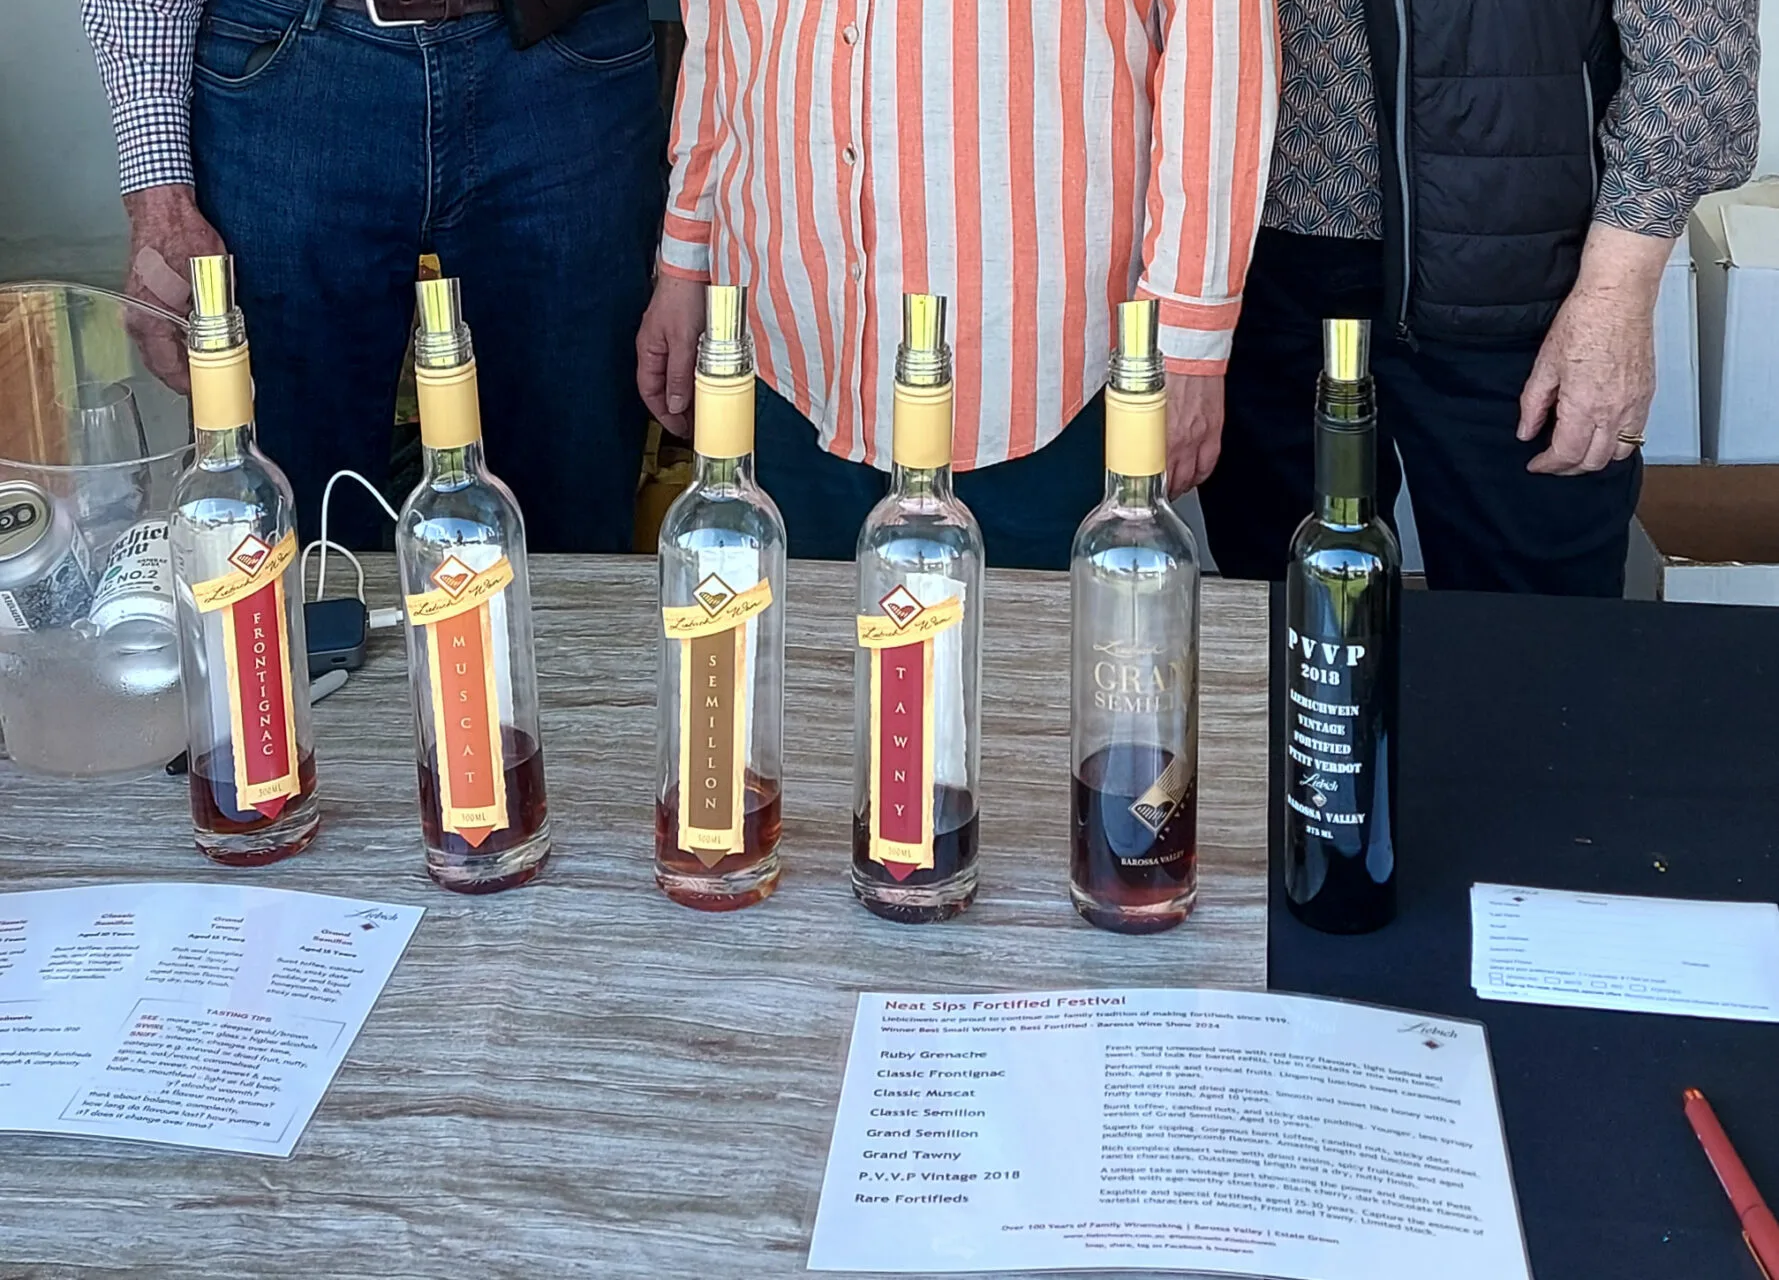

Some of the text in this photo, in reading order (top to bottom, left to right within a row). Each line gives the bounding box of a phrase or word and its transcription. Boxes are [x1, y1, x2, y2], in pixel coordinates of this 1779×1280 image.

[117, 570, 158, 584] NO.2
[1300, 663, 1341, 686] 2018
[253, 612, 275, 757] FRONTIGNAC
[452, 635, 475, 784] MUSCAT
[1290, 688, 1360, 716] LIEBICHWEIN
[704, 654, 719, 810] SEMILLON
[1297, 713, 1346, 736] VINTAGE
[893, 666, 909, 818] TAWNY
[1293, 730, 1352, 755] FORTIFIED
[1288, 744, 1363, 774] PETIT VERDOT
[1287, 794, 1366, 825] BAROSSA VALLEY
[1121, 850, 1185, 866] BAROSSA VALLEY
[885, 996, 1126, 1013] Neat Sips Fortified Festival
[206, 1008, 272, 1022] TASTING TIPS
[1064, 1012, 1093, 1020] family
[1153, 1011, 1187, 1019] making
[972, 1025, 1007, 1035] Winery
[880, 1050, 987, 1061] Ruby Grenache
[877, 1069, 1006, 1080] Classic Frontignac
[873, 1088, 976, 1098] Classic Muscat
[869, 1108, 986, 1118] Classic Semillon
[866, 1128, 979, 1138] Grand Semillon
[862, 1150, 962, 1162] Grand Tawny
[858, 1170, 1020, 1183] P.V.V.P Vintage 2018
[1191, 1168, 1230, 1178] vintage
[1233, 1171, 1255, 1179] port
[1258, 1173, 1317, 1187] showcasing
[1320, 1180, 1340, 1189] the
[1341, 1183, 1374, 1194] power
[1377, 1189, 1396, 1199] and
[1399, 1192, 1430, 1205] depth
[1432, 1199, 1443, 1207] of
[854, 1193, 969, 1204] Rare Fortifieds
[1283, 1184, 1311, 1193] Black
[1355, 1193, 1379, 1204] dark
[1382, 1197, 1433, 1214] chocolate
[1099, 1196, 1140, 1204] varietal
[1143, 1197, 1199, 1206] characters
[1296, 1208, 1316, 1217] and
[1360, 1216, 1402, 1230] Limited
[1100, 1188, 1147, 1198] Exquisite
[1173, 1189, 1210, 1199] special
[1265, 1196, 1291, 1206] aged
[1362, 1208, 1404, 1223] Capture
[1407, 1217, 1426, 1226] the
[1428, 1221, 1471, 1234] essence
[1473, 1228, 1485, 1237] of
[1001, 1224, 1025, 1232] Over
[1090, 1221, 1122, 1230] Family
[1124, 1222, 1183, 1231] Winemaking
[1233, 1227, 1264, 1237] Valley
